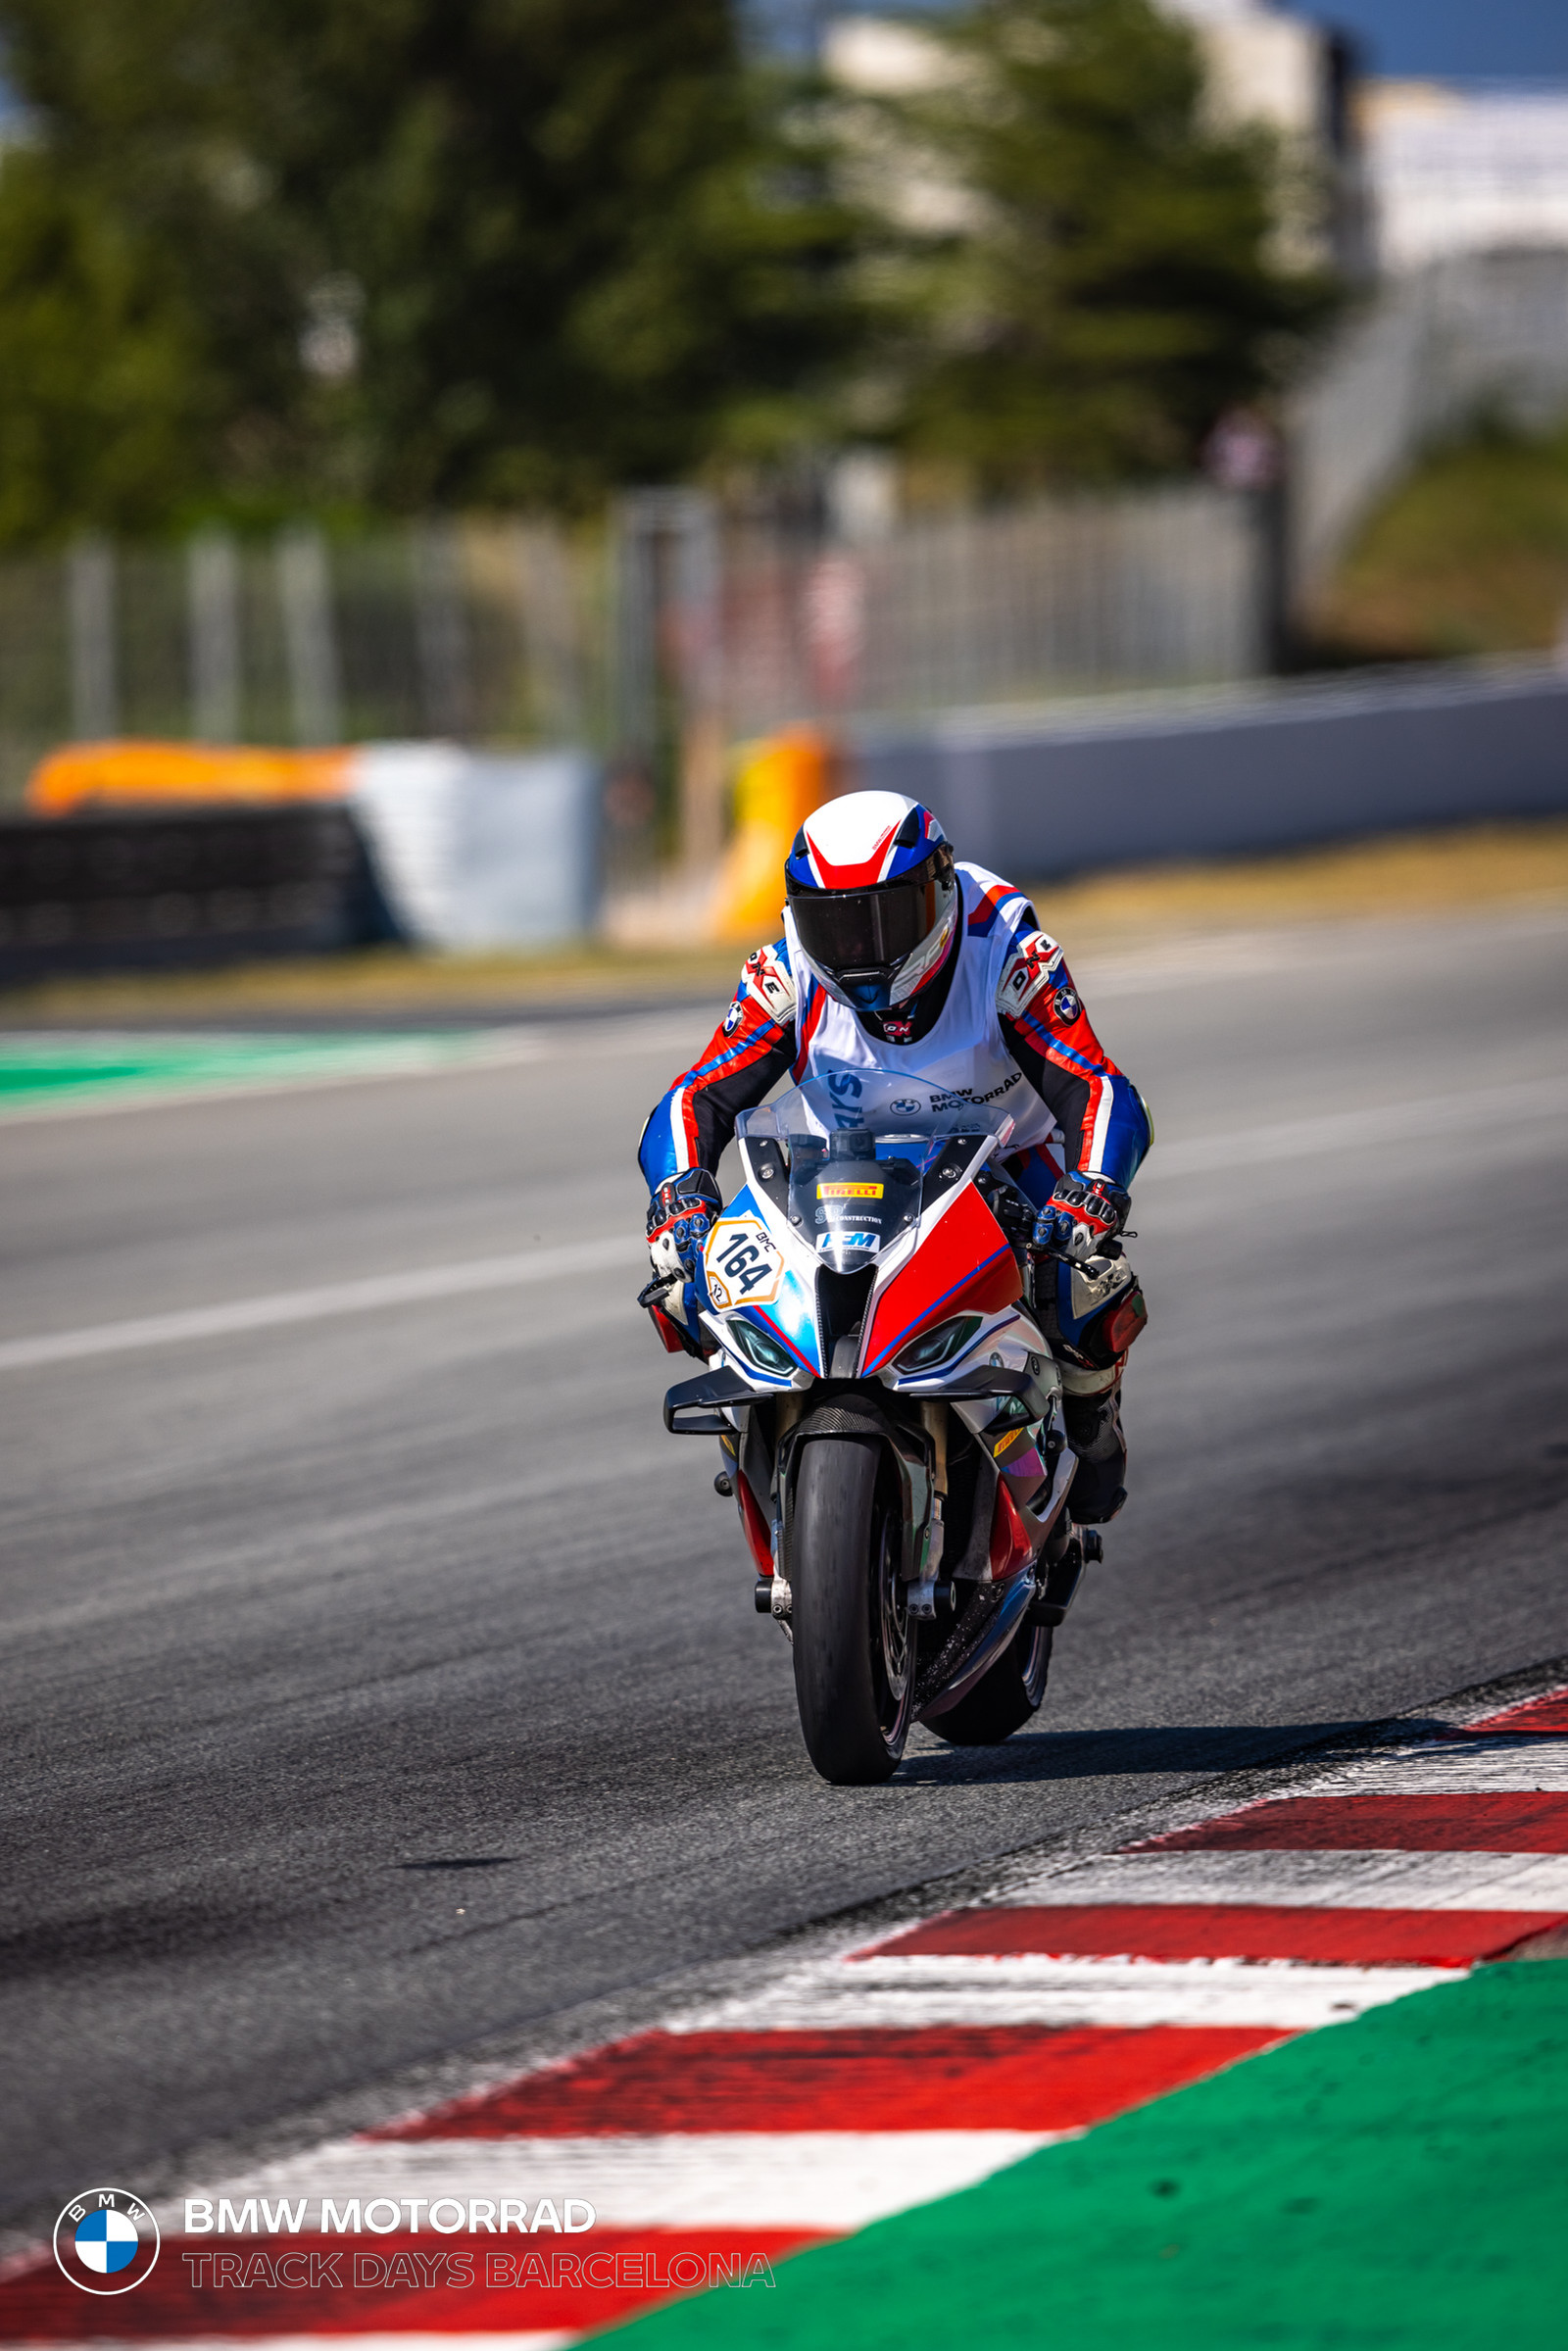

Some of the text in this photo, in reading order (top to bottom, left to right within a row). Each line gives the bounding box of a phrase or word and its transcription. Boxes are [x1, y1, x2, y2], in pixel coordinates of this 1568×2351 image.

[929, 1088, 973, 1103] BMW
[931, 1072, 1022, 1112] MOTORRAD
[824, 1185, 878, 1196] PIRELLI
[716, 1233, 772, 1295] 164
[713, 1284, 723, 1302] 12
